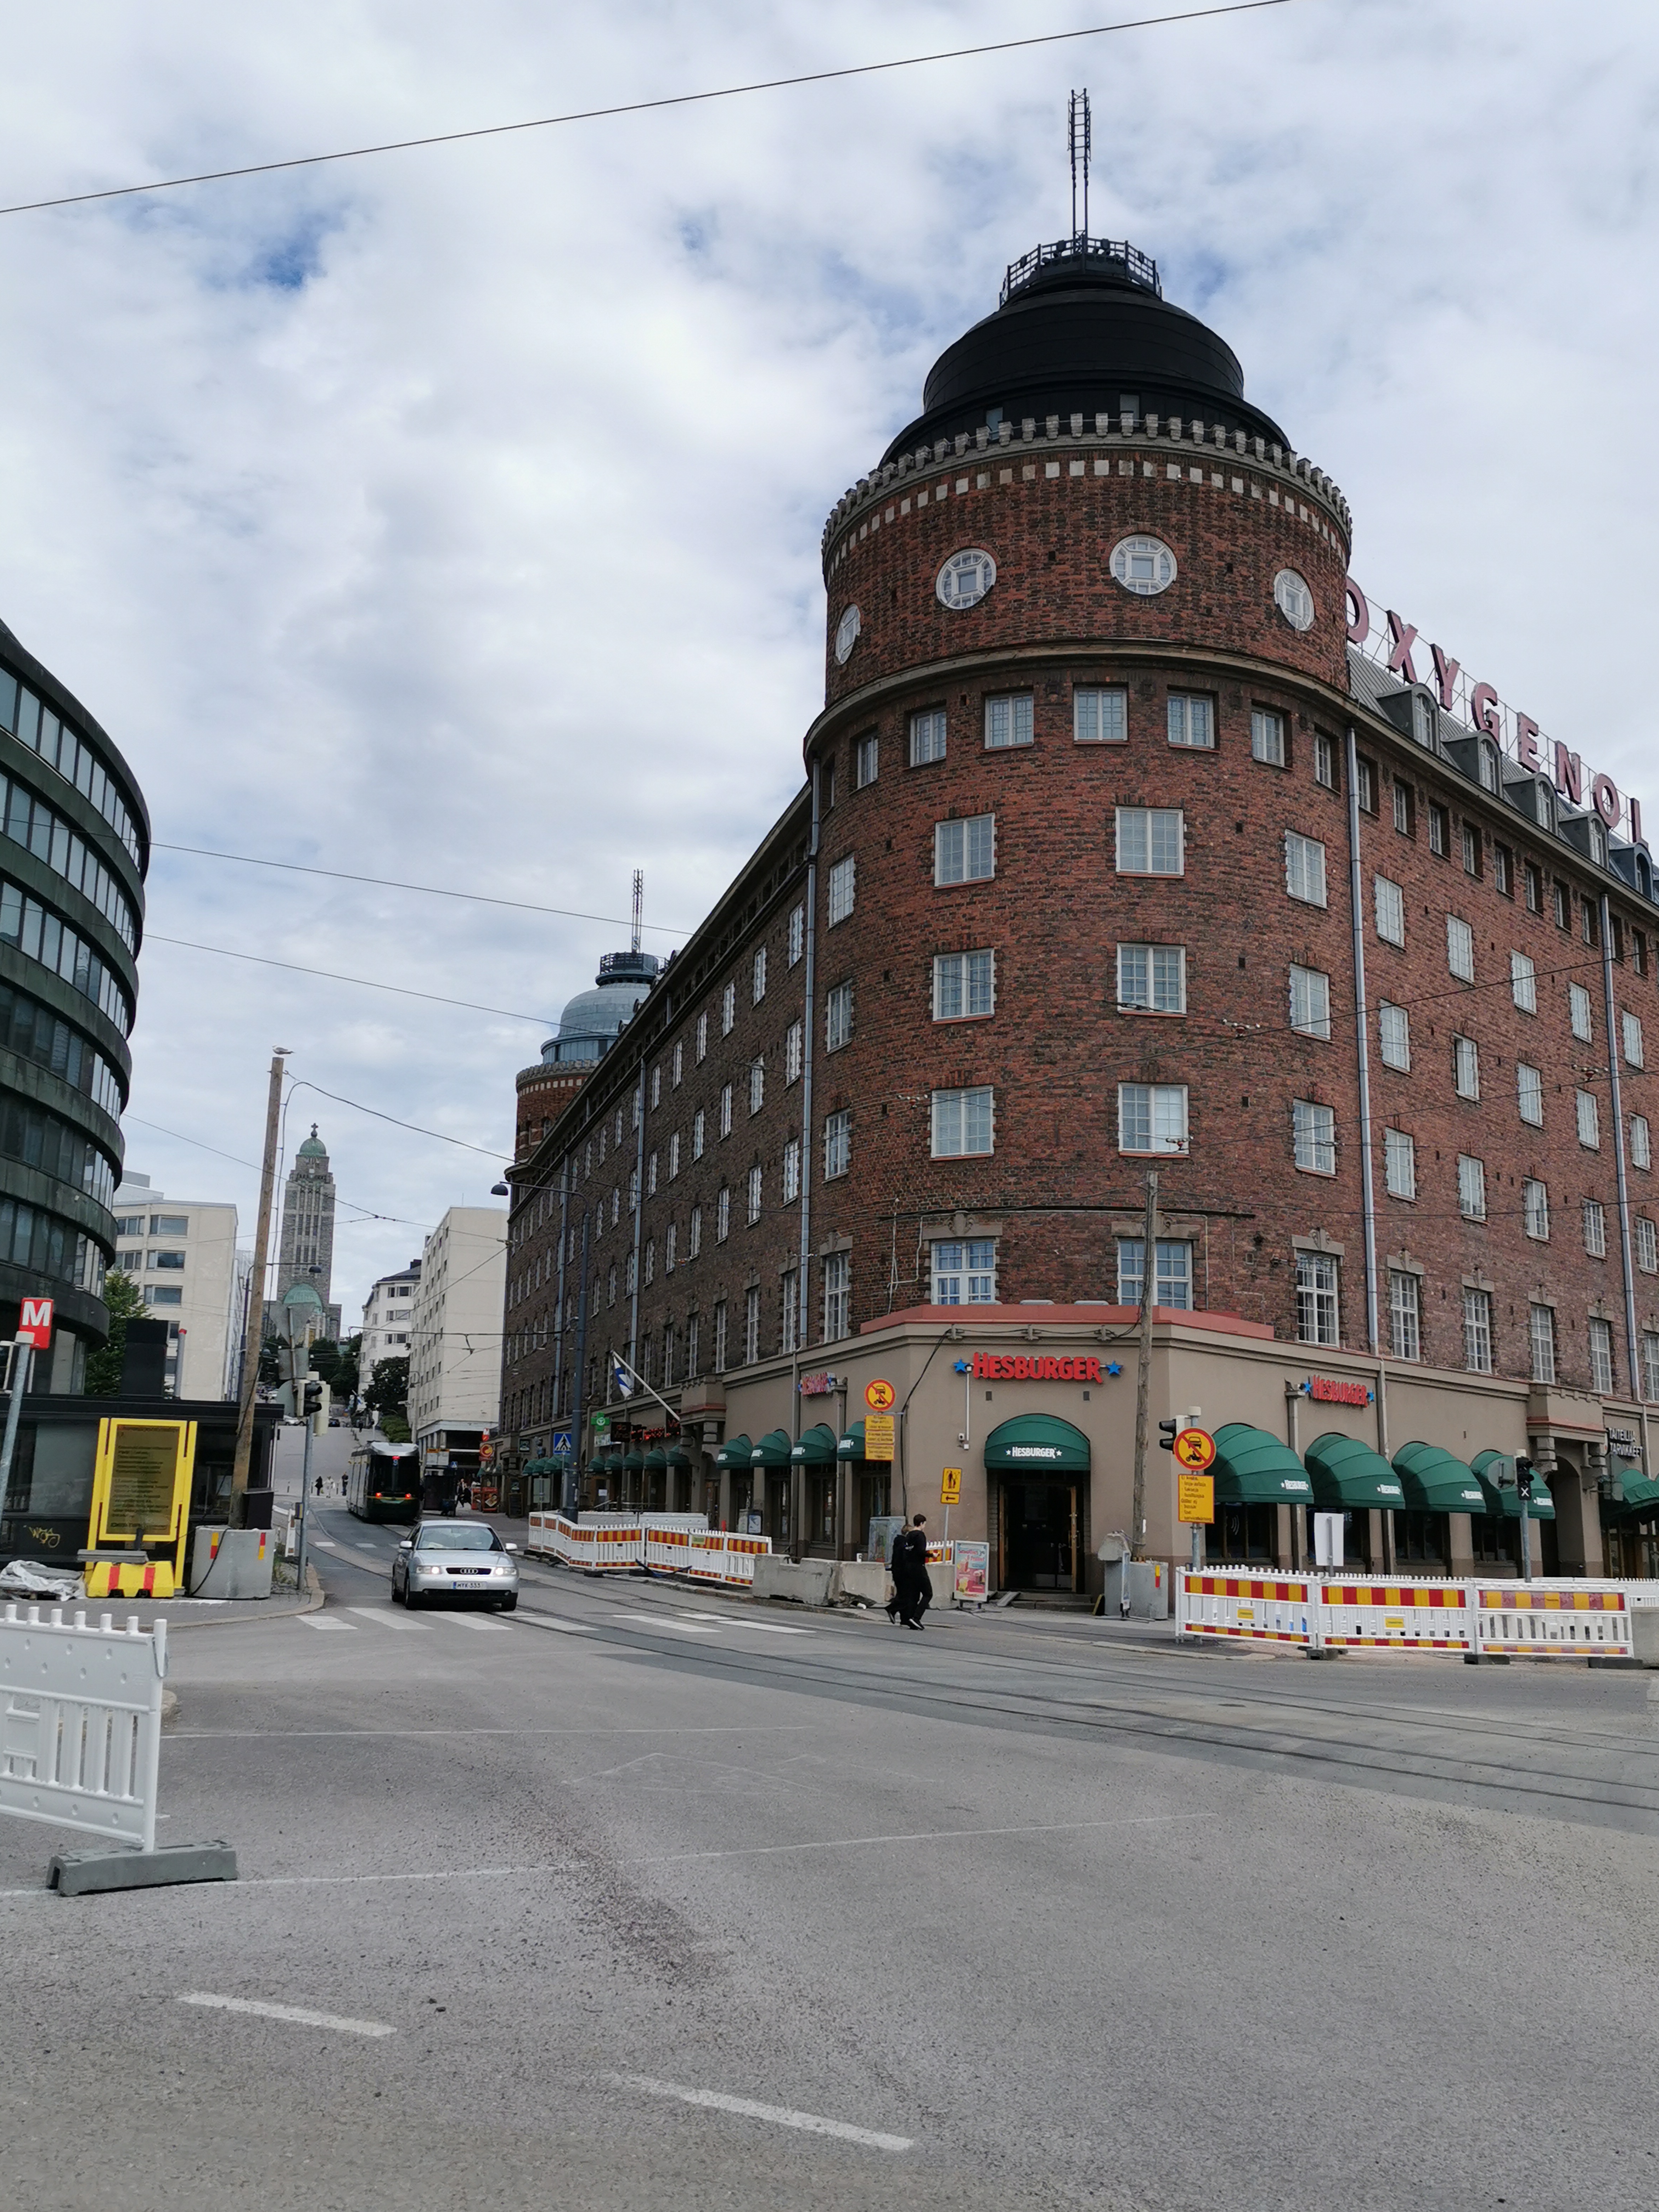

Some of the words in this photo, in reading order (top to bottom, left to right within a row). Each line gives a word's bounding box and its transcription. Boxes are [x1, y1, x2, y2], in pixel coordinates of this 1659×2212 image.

[22, 1301, 51, 1326] M
[973, 1352, 1103, 1384] HESBURGER
[1313, 1375, 1368, 1408] HESBURGER
[1012, 1446, 1056, 1459] HESBURGER
